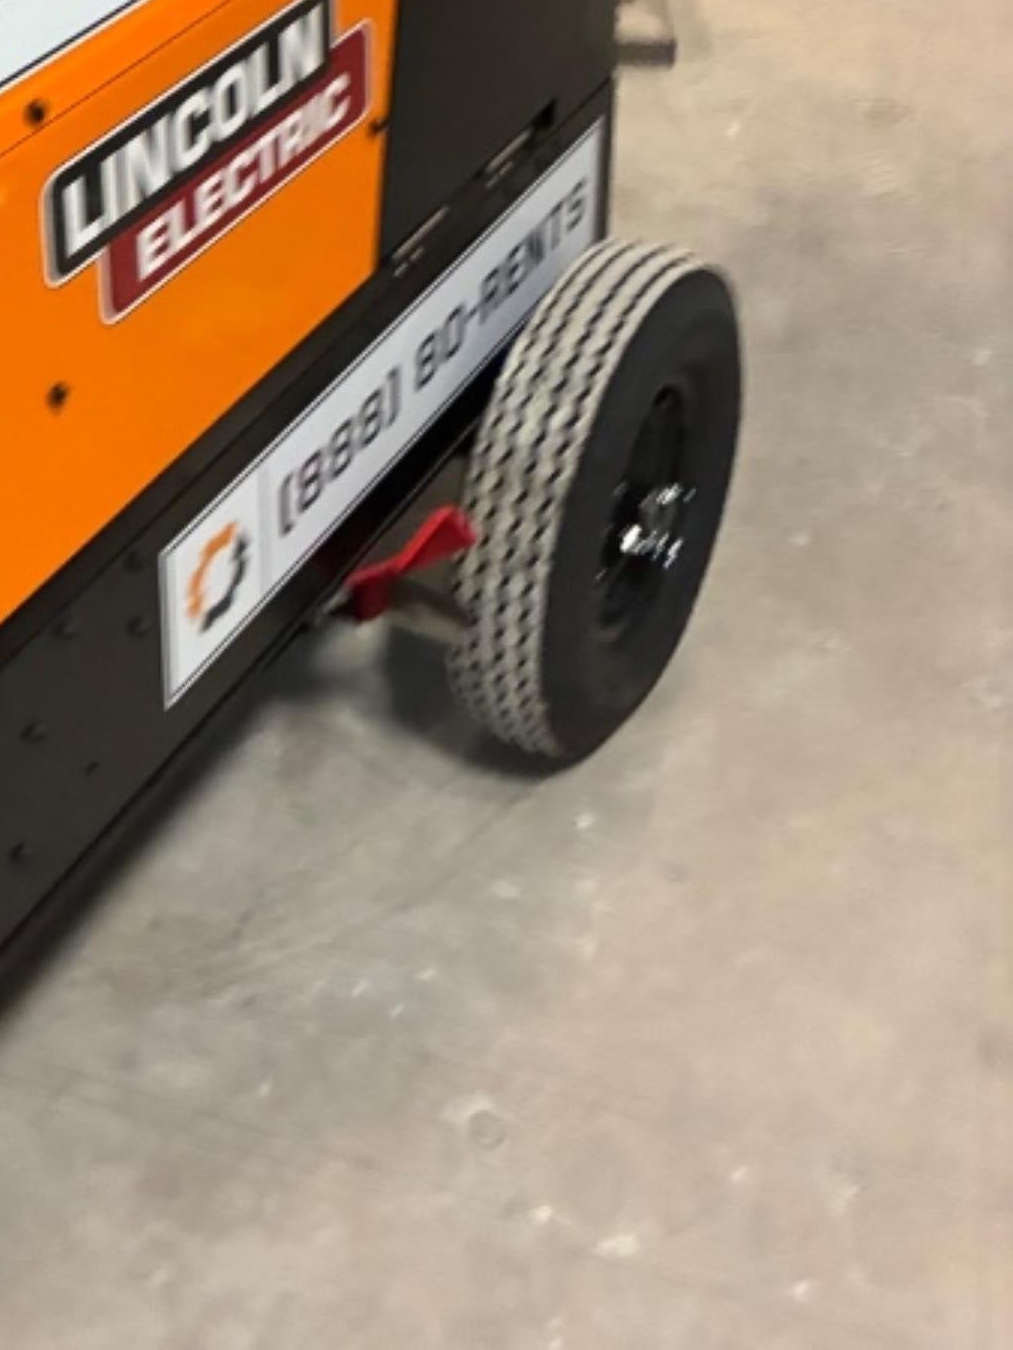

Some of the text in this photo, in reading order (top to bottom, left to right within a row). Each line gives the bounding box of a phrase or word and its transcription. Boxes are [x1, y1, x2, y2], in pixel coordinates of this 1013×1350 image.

[59, 0, 326, 257] LINCOLN
[137, 73, 351, 282] ELECTRIC
[277, 178, 588, 538] (888) 80-RENTS
